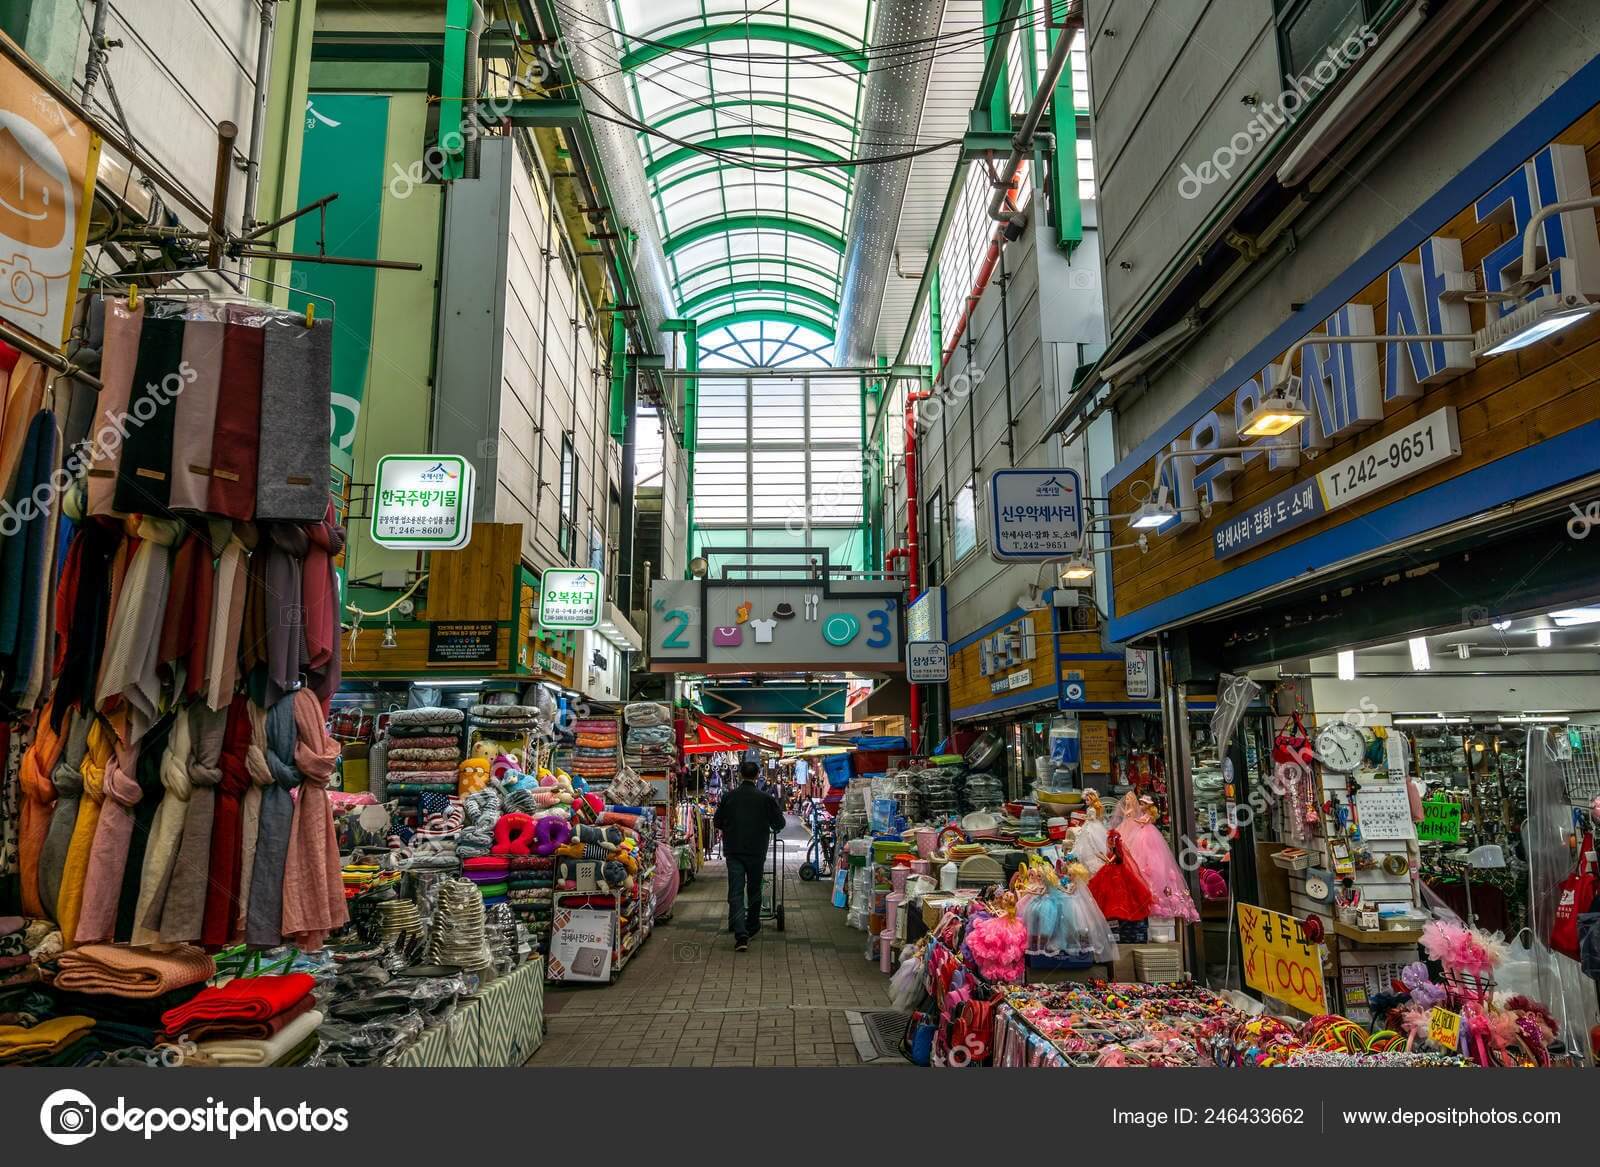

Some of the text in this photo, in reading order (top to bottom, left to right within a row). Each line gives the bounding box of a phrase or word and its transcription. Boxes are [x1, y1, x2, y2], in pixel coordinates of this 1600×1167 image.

[1330, 425, 1435, 497] T.242-9651
[382, 489, 457, 507] 한국주방기물
[1001, 505, 1076, 522] 신우악세사리
[389, 526, 444, 535] T.246-8600
[1012, 540, 1068, 550] T.242-9651
[546, 591, 594, 605] 오복침구
[662, 609, 690, 649] 2
[866, 609, 892, 649] 3
[913, 656, 946, 667] 삼성도기
